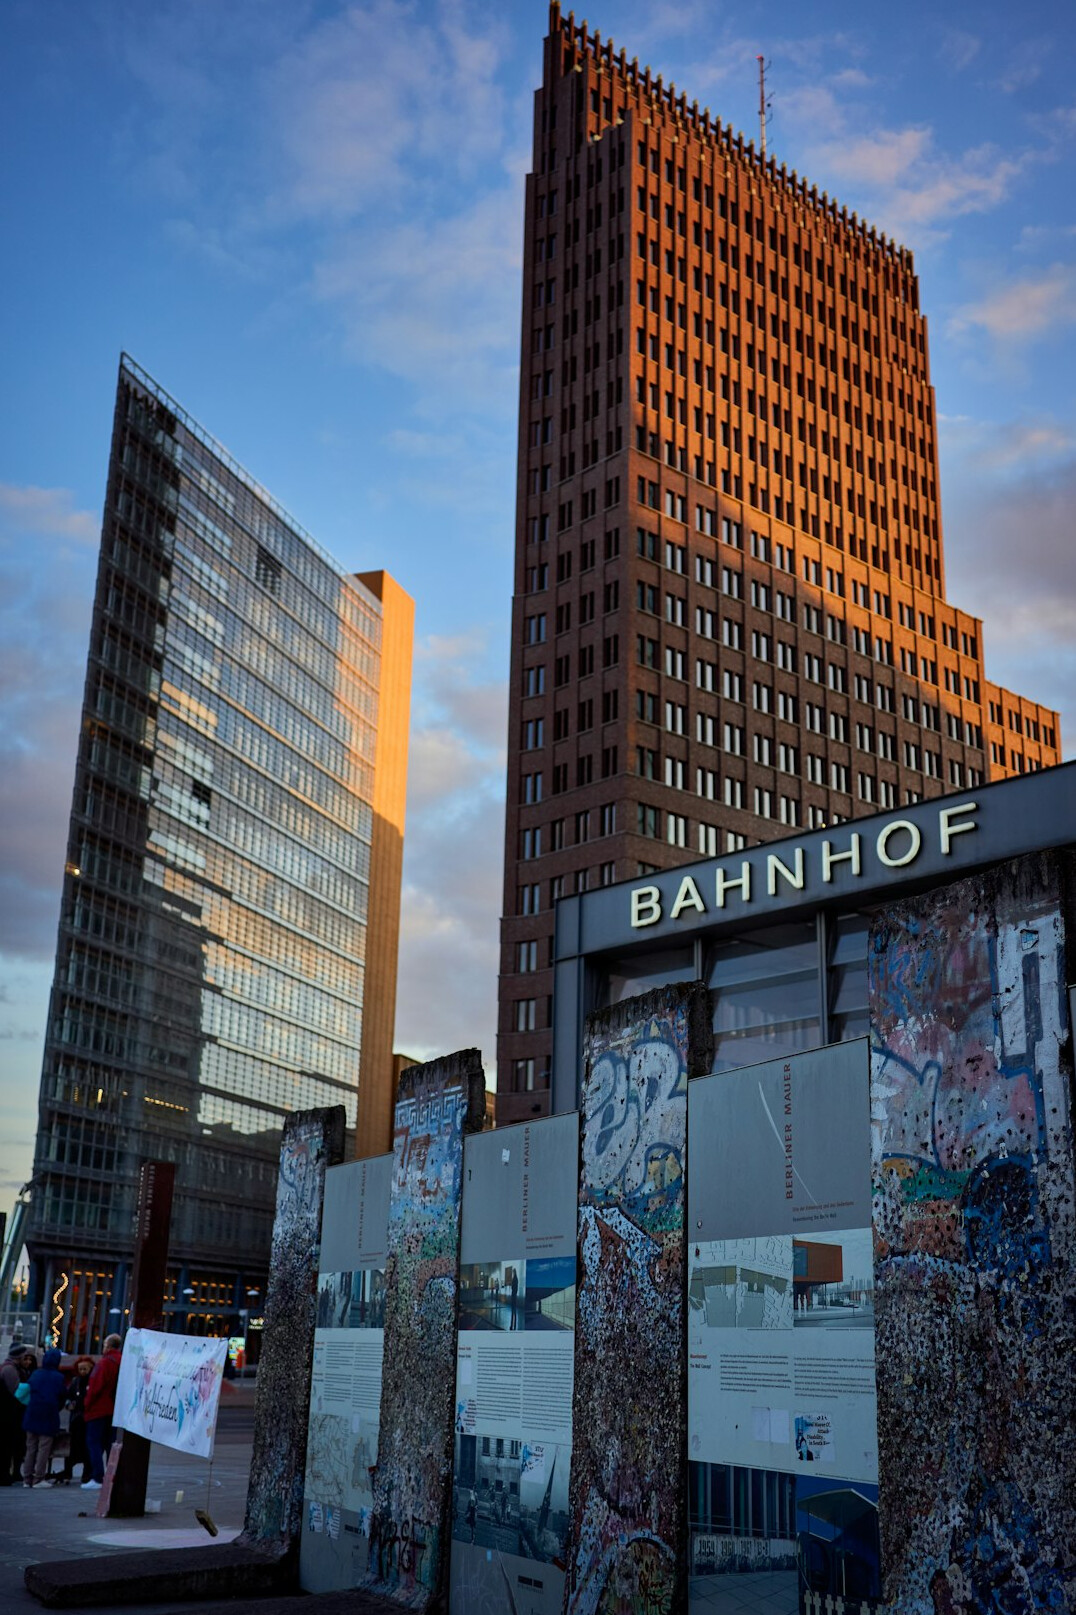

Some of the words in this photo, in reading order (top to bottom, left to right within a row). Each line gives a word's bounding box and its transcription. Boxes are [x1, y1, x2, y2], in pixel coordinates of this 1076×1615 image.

[629, 802, 980, 928] BAHNHOF
[784, 1063, 792, 1115] MAUER
[785, 1123, 793, 1199] BERLINER
